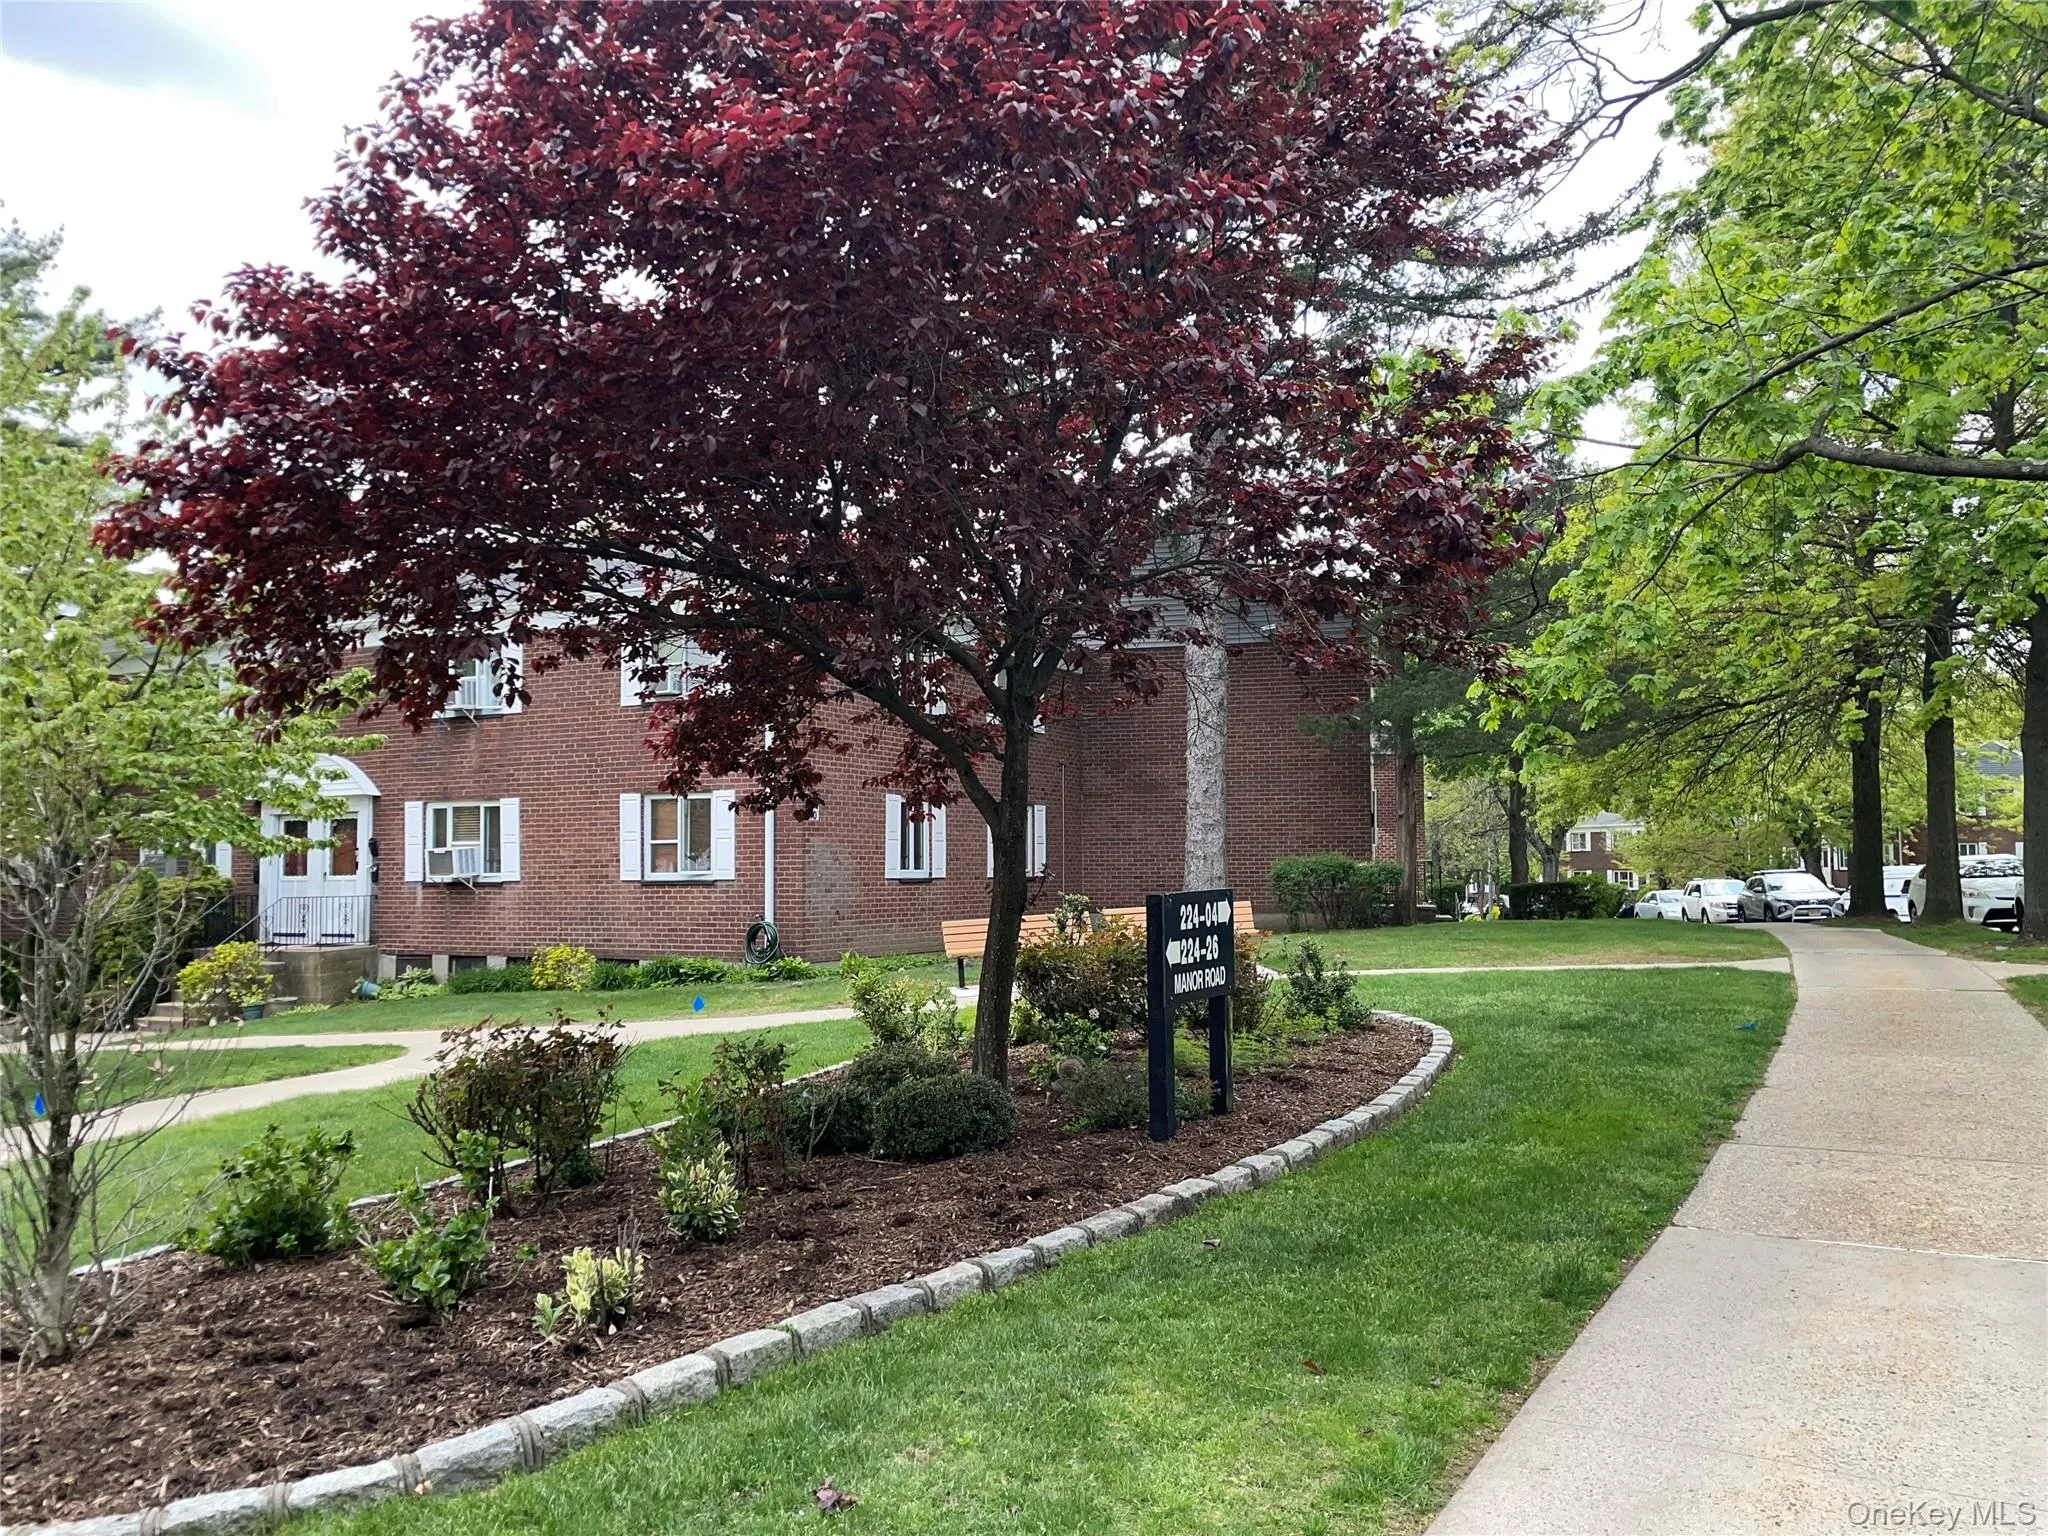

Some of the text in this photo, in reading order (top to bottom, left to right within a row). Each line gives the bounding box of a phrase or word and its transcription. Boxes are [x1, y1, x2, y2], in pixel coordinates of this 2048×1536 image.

[1180, 902, 1218, 931] 224-04
[1181, 934, 1219, 965] 224-26
[1174, 966, 1226, 994] MANOR ROAD
